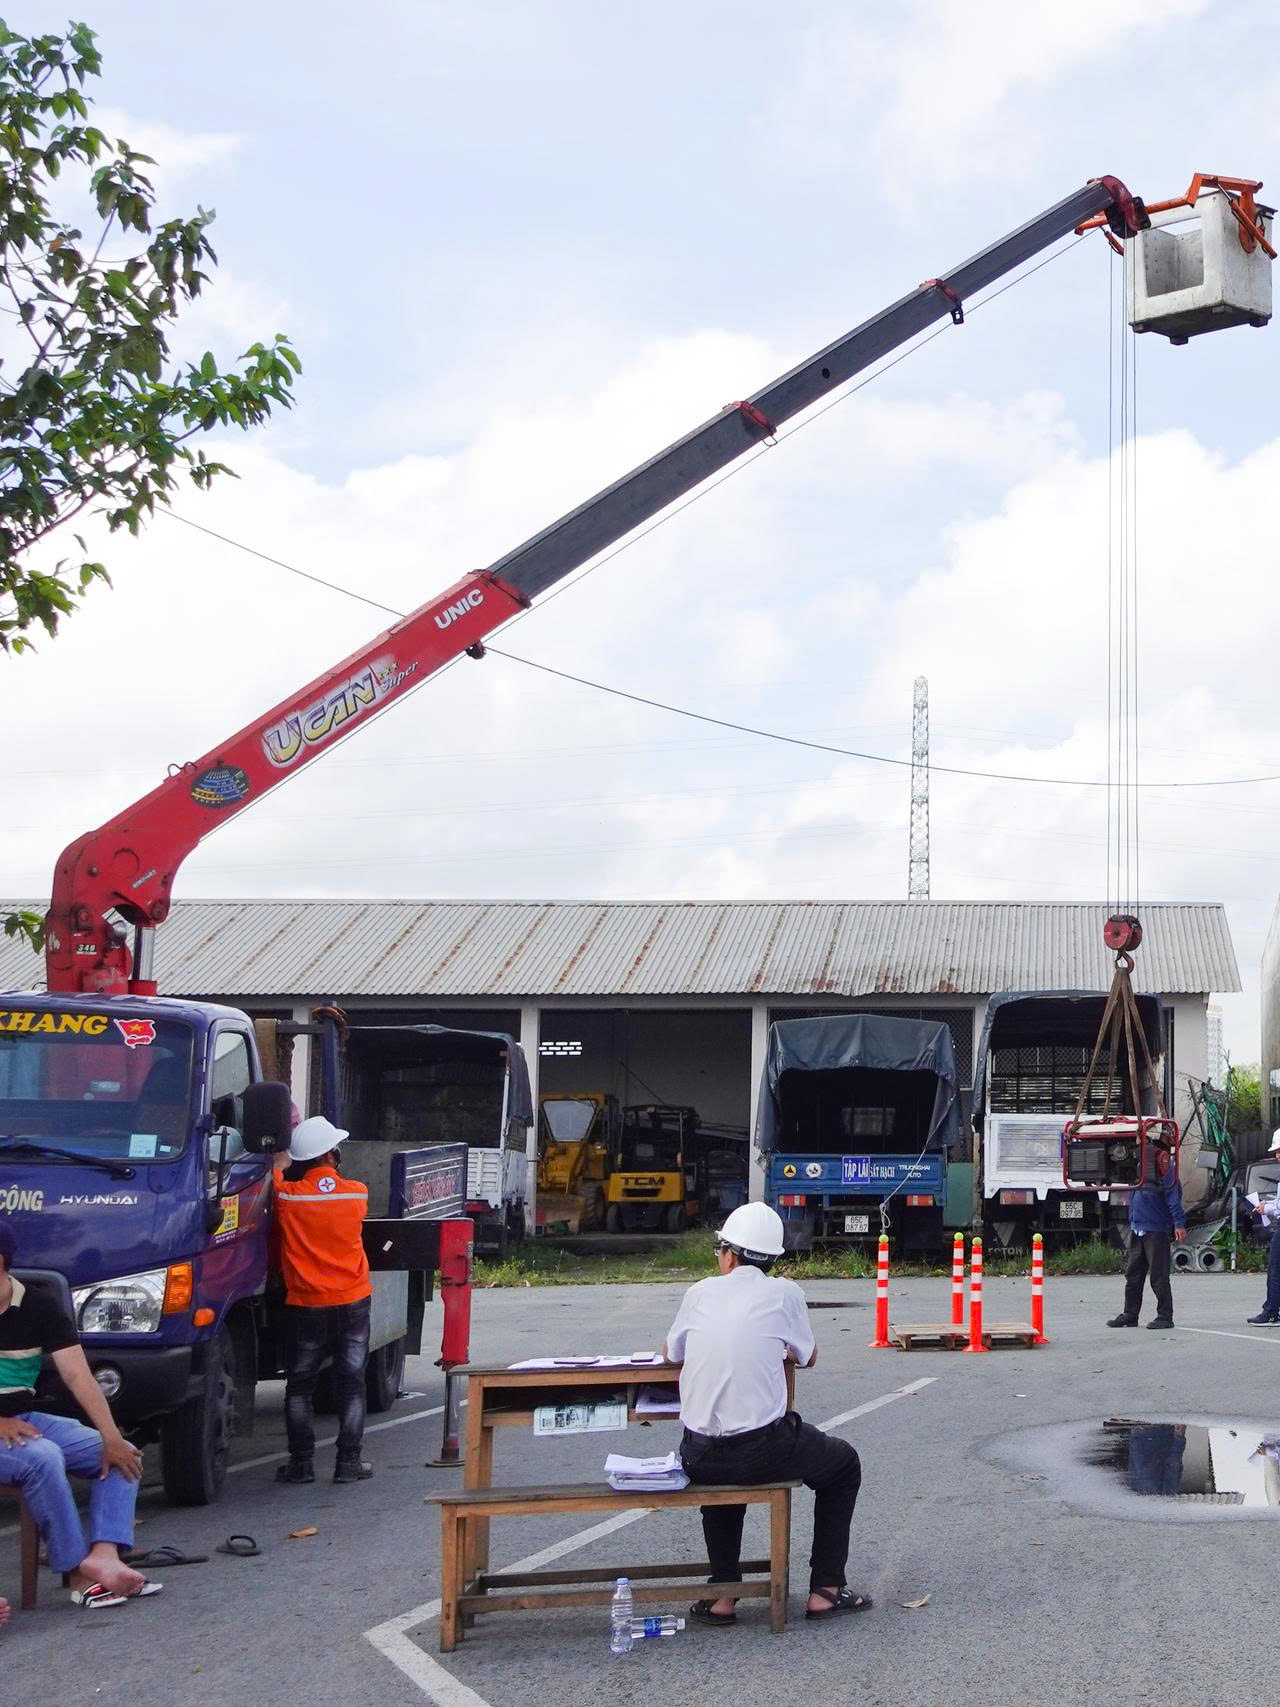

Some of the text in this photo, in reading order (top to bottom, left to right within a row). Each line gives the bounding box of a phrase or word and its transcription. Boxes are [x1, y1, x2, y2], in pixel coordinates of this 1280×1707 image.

[434, 588, 484, 629] UNIC
[266, 672, 376, 764] UCAN
[620, 1176, 665, 1185] TCM
[844, 1160, 856, 1181] TẬP
[60, 1194, 138, 1205] HYUNDAI
